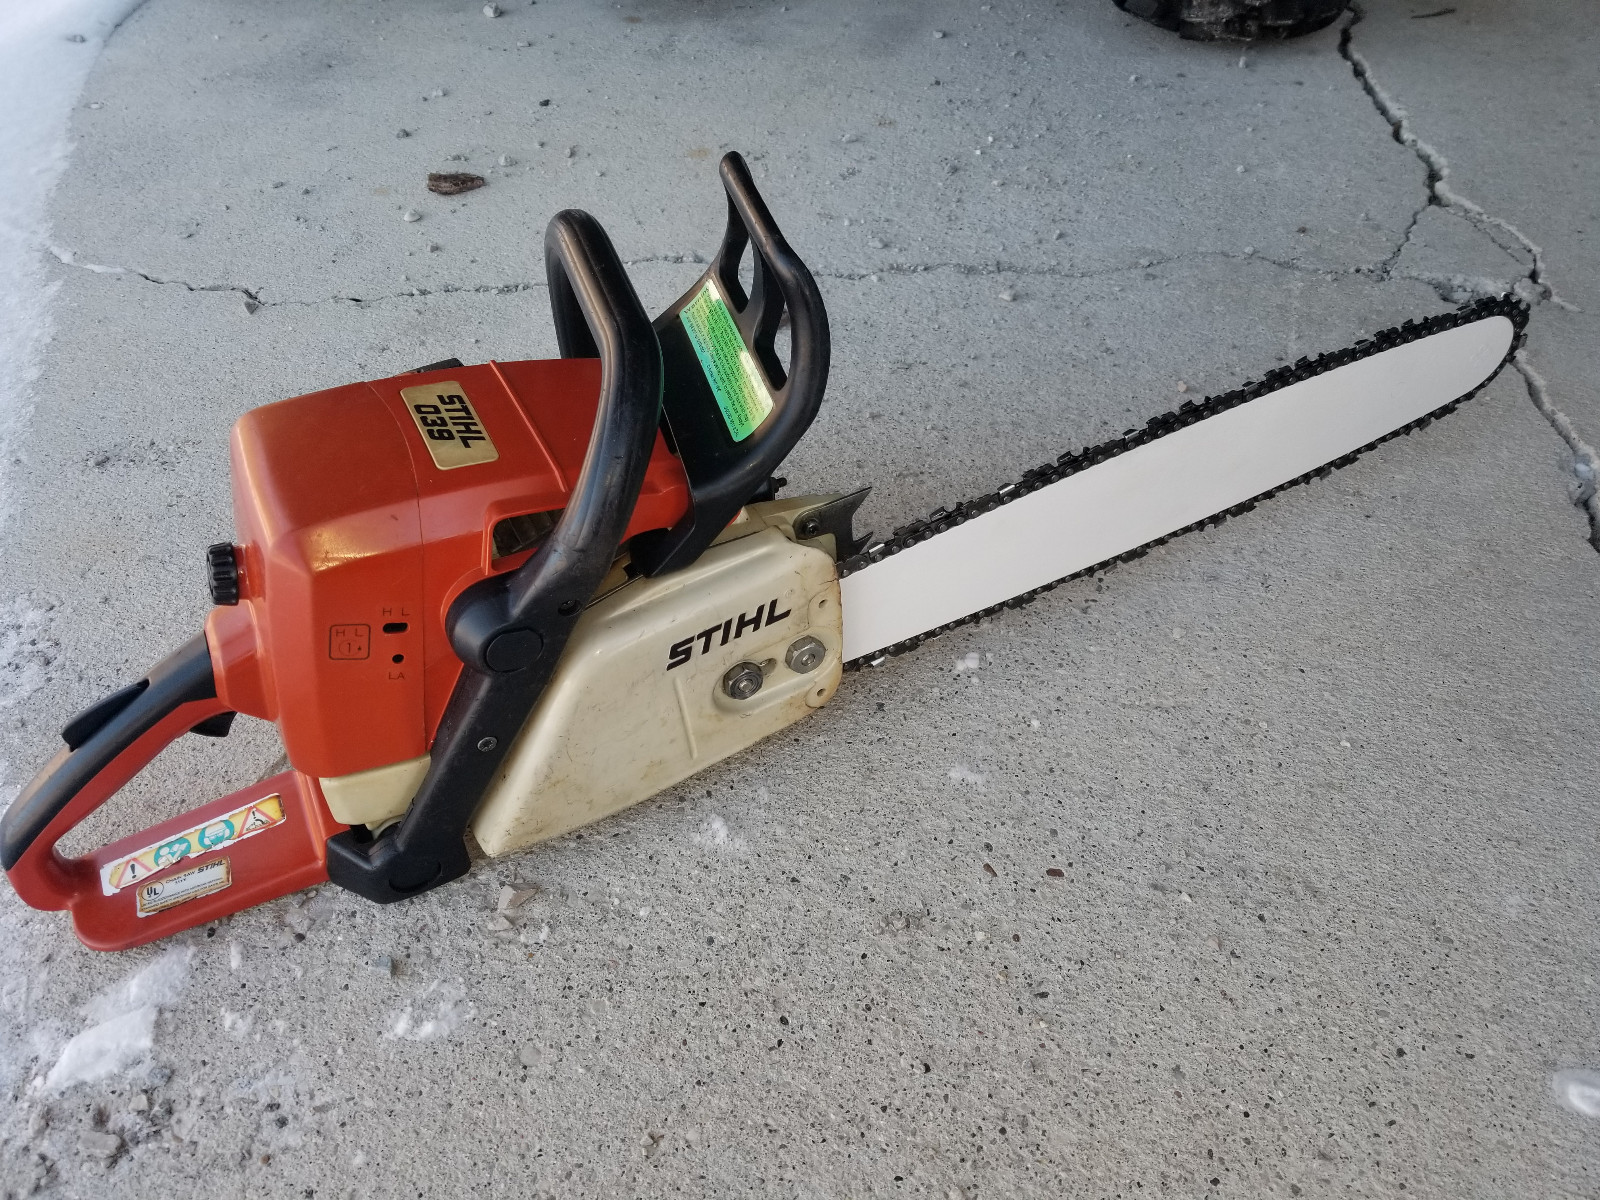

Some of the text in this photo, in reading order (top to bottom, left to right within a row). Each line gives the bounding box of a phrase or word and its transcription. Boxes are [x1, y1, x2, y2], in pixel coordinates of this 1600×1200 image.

[413, 404, 456, 441] 039
[436, 394, 486, 449] STIHL
[382, 607, 410, 616] H L
[336, 628, 364, 637] H L
[666, 598, 792, 671] STIHL
[388, 671, 405, 680] LA
[197, 860, 226, 874] STIHL
